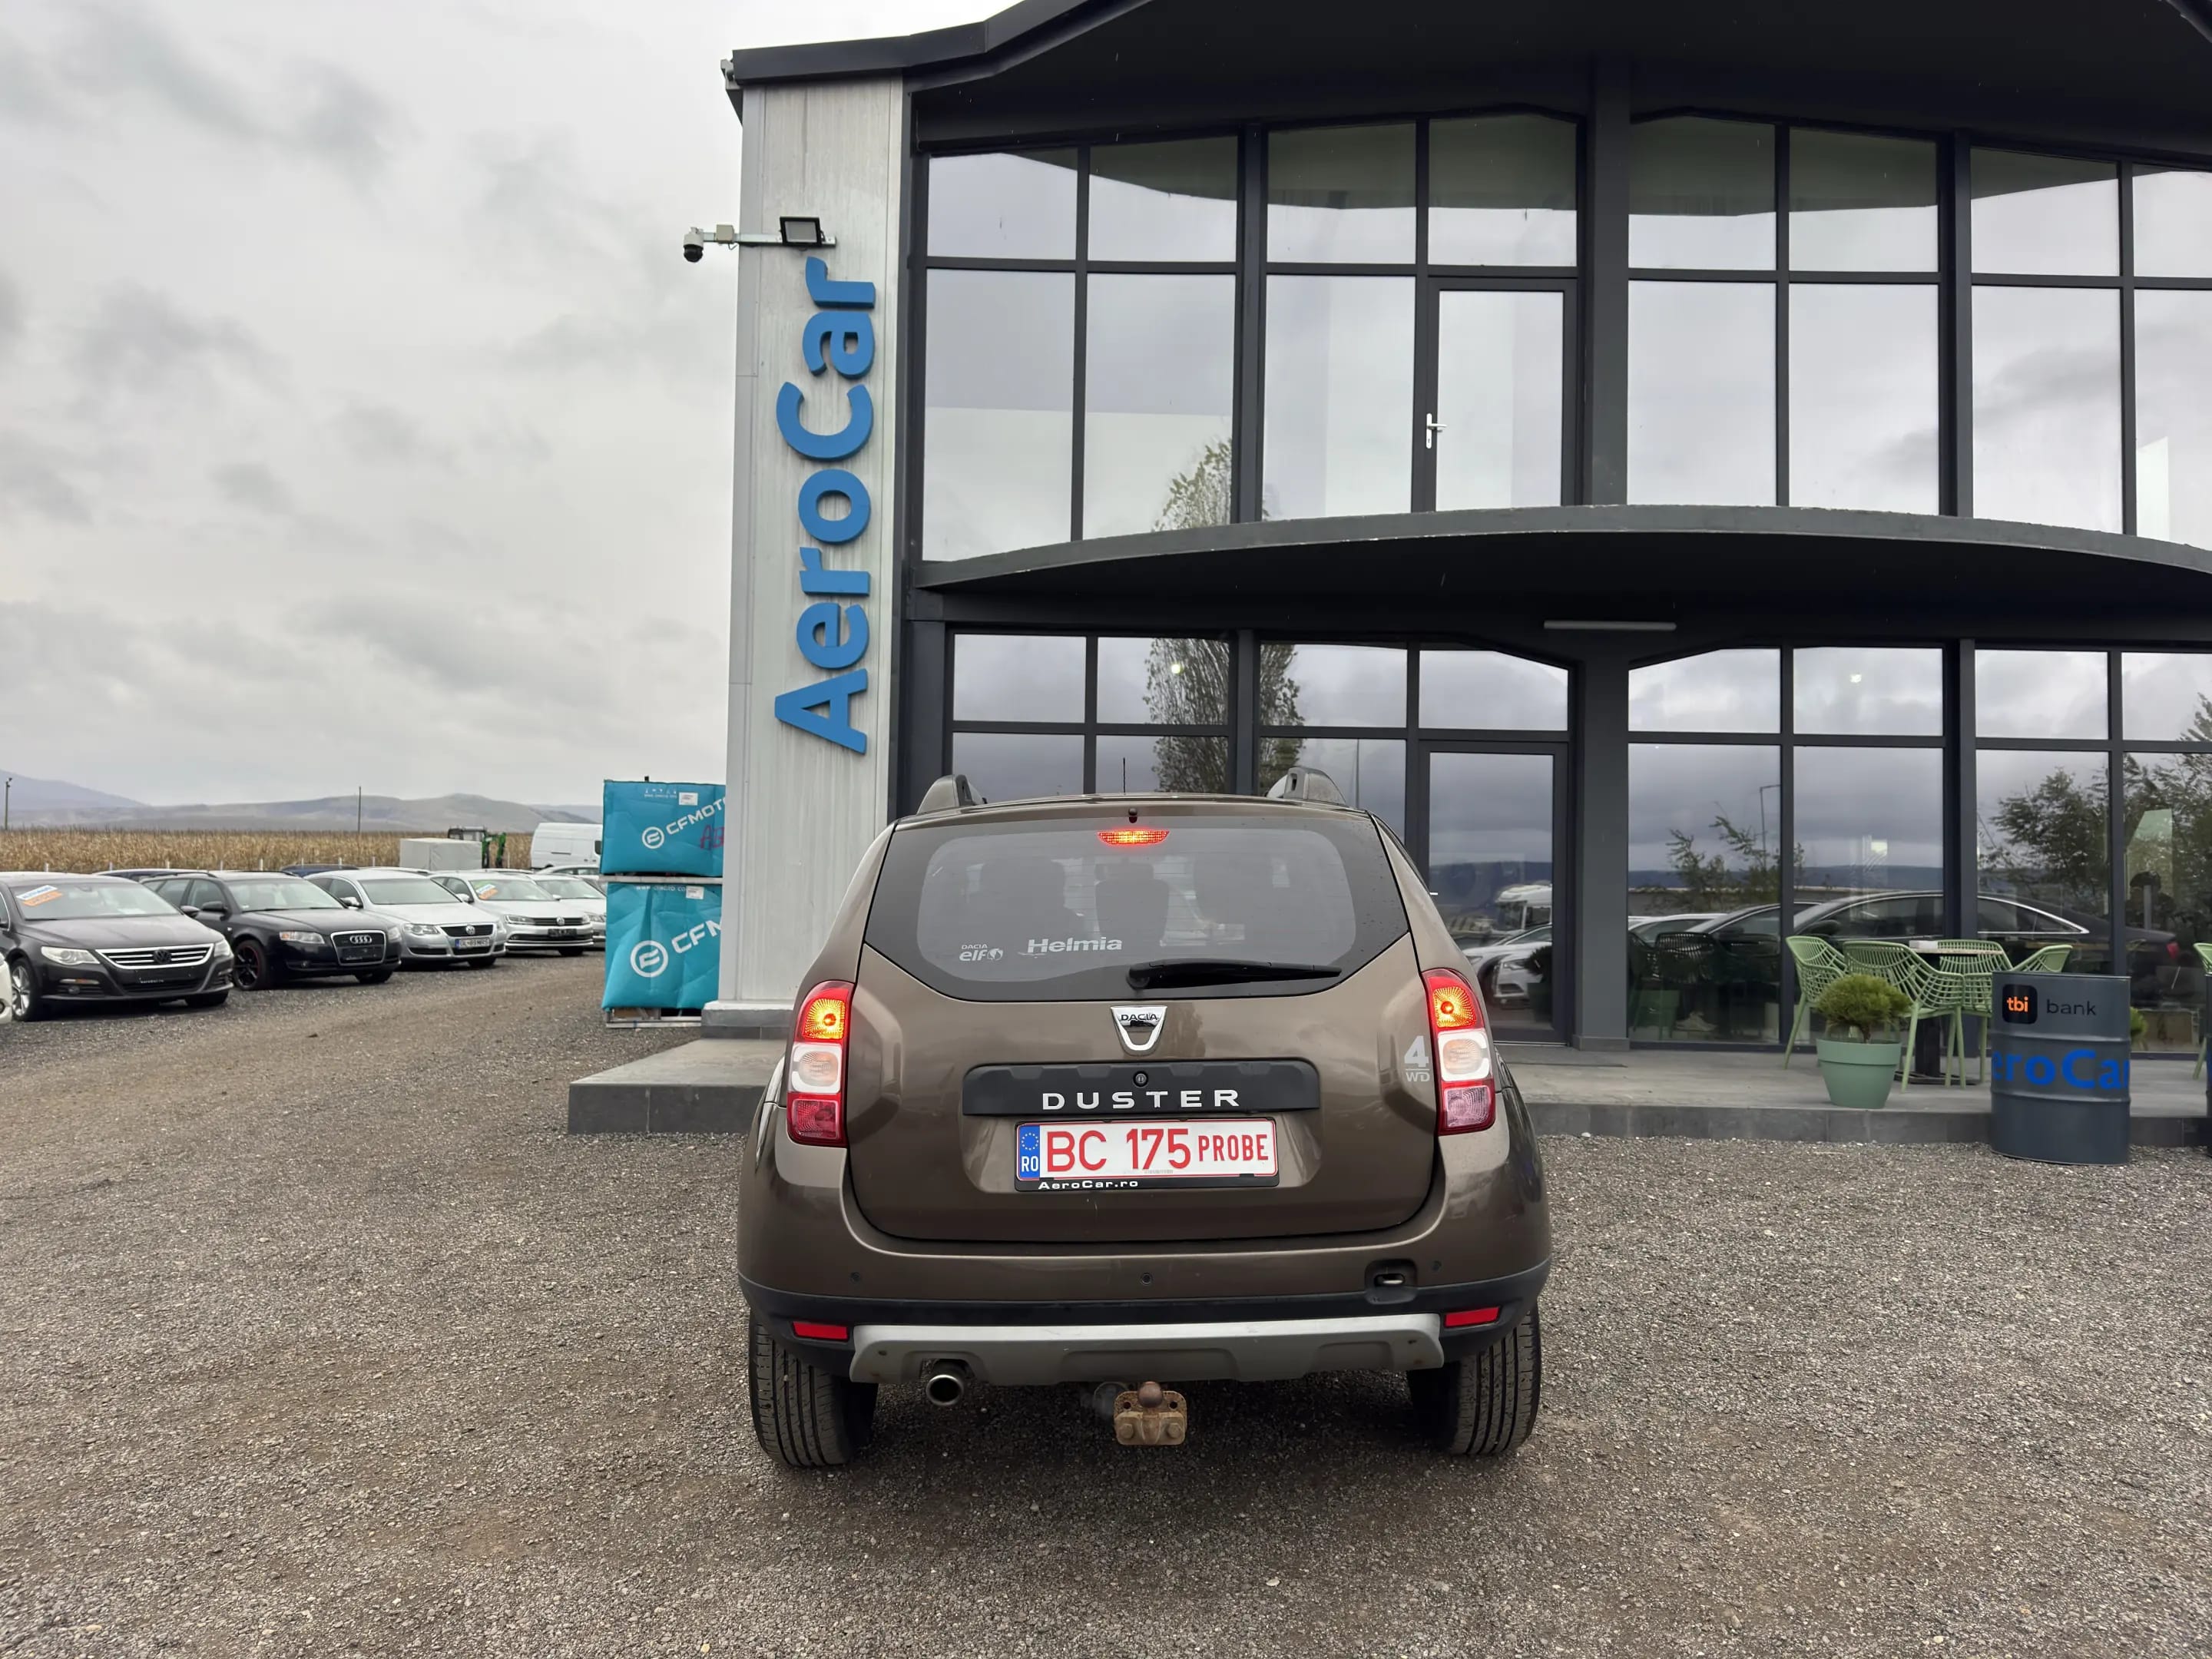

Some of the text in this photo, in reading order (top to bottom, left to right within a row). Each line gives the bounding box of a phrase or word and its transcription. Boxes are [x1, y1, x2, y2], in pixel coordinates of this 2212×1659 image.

[775, 256, 876, 756] AeroCar
[666, 797, 726, 835] CFMOT
[1027, 936, 1123, 953] Helmia
[959, 949, 988, 962] elf
[2006, 996, 2097, 1016] tbi bank
[1404, 1035, 1429, 1068] 4
[1406, 1071, 1430, 1082] WD
[1042, 1089, 1240, 1111] DUSTER
[1021, 1128, 1269, 1173] RO BC 175 PROBE
[1038, 1180, 1139, 1190] AeroCar.ro
